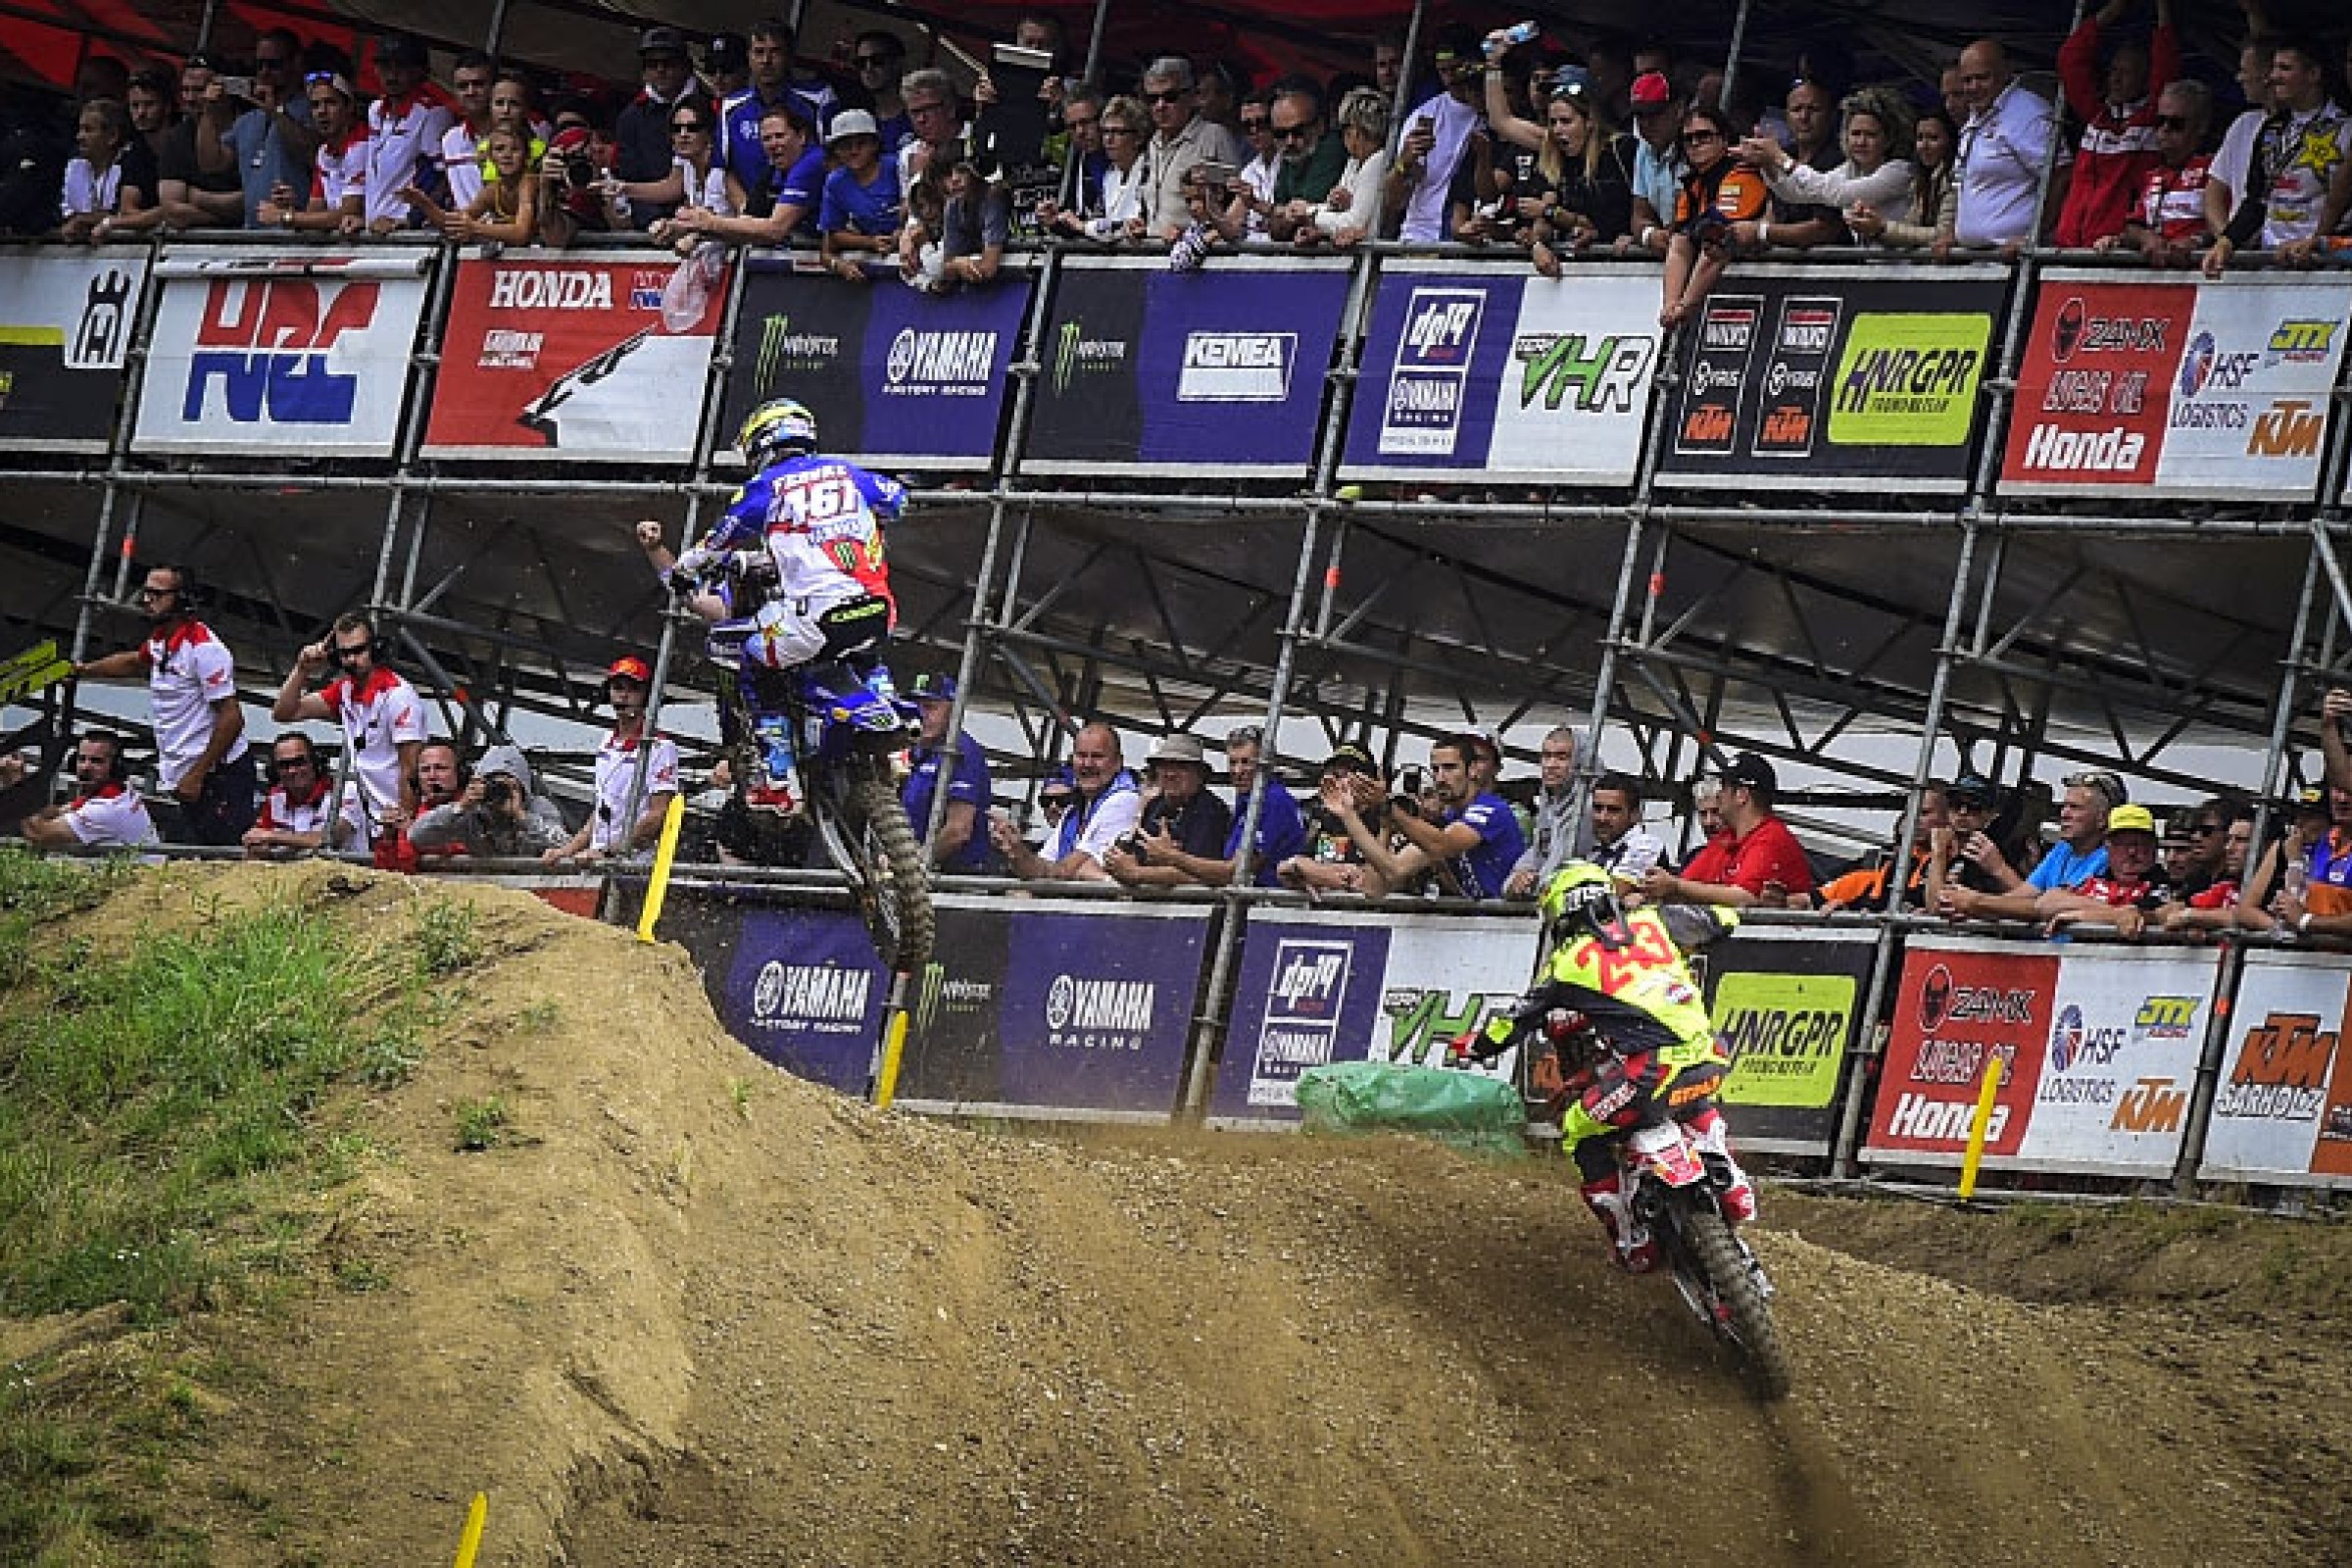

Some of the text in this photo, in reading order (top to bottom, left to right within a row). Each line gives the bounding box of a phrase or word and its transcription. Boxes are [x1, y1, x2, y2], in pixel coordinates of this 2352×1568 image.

[490, 270, 612, 309] HONDA
[912, 331, 998, 381] YAMAHA
[1191, 337, 1283, 368] KEMEA
[2207, 353, 2260, 389] HSF
[1517, 336, 1656, 413] VHR
[1837, 347, 1979, 413] HNRGPR
[1684, 403, 1736, 440] KTM
[1761, 404, 1812, 442] KTM
[2169, 402, 2249, 429] LOGISTICS
[2245, 399, 2326, 458] KTM
[2022, 423, 2146, 471] Honda
[782, 965, 871, 1020] YAMAHA
[1074, 981, 1154, 1032] YAMAHA
[1049, 1034, 1142, 1051] RACING
[2079, 1029, 2127, 1065] HSF
[2230, 1012, 2338, 1088] KTM
[2039, 1078, 2115, 1106] LOGISTICS
[2108, 1077, 2187, 1133] KTM
[2217, 1085, 2325, 1120] SARHOLZ
